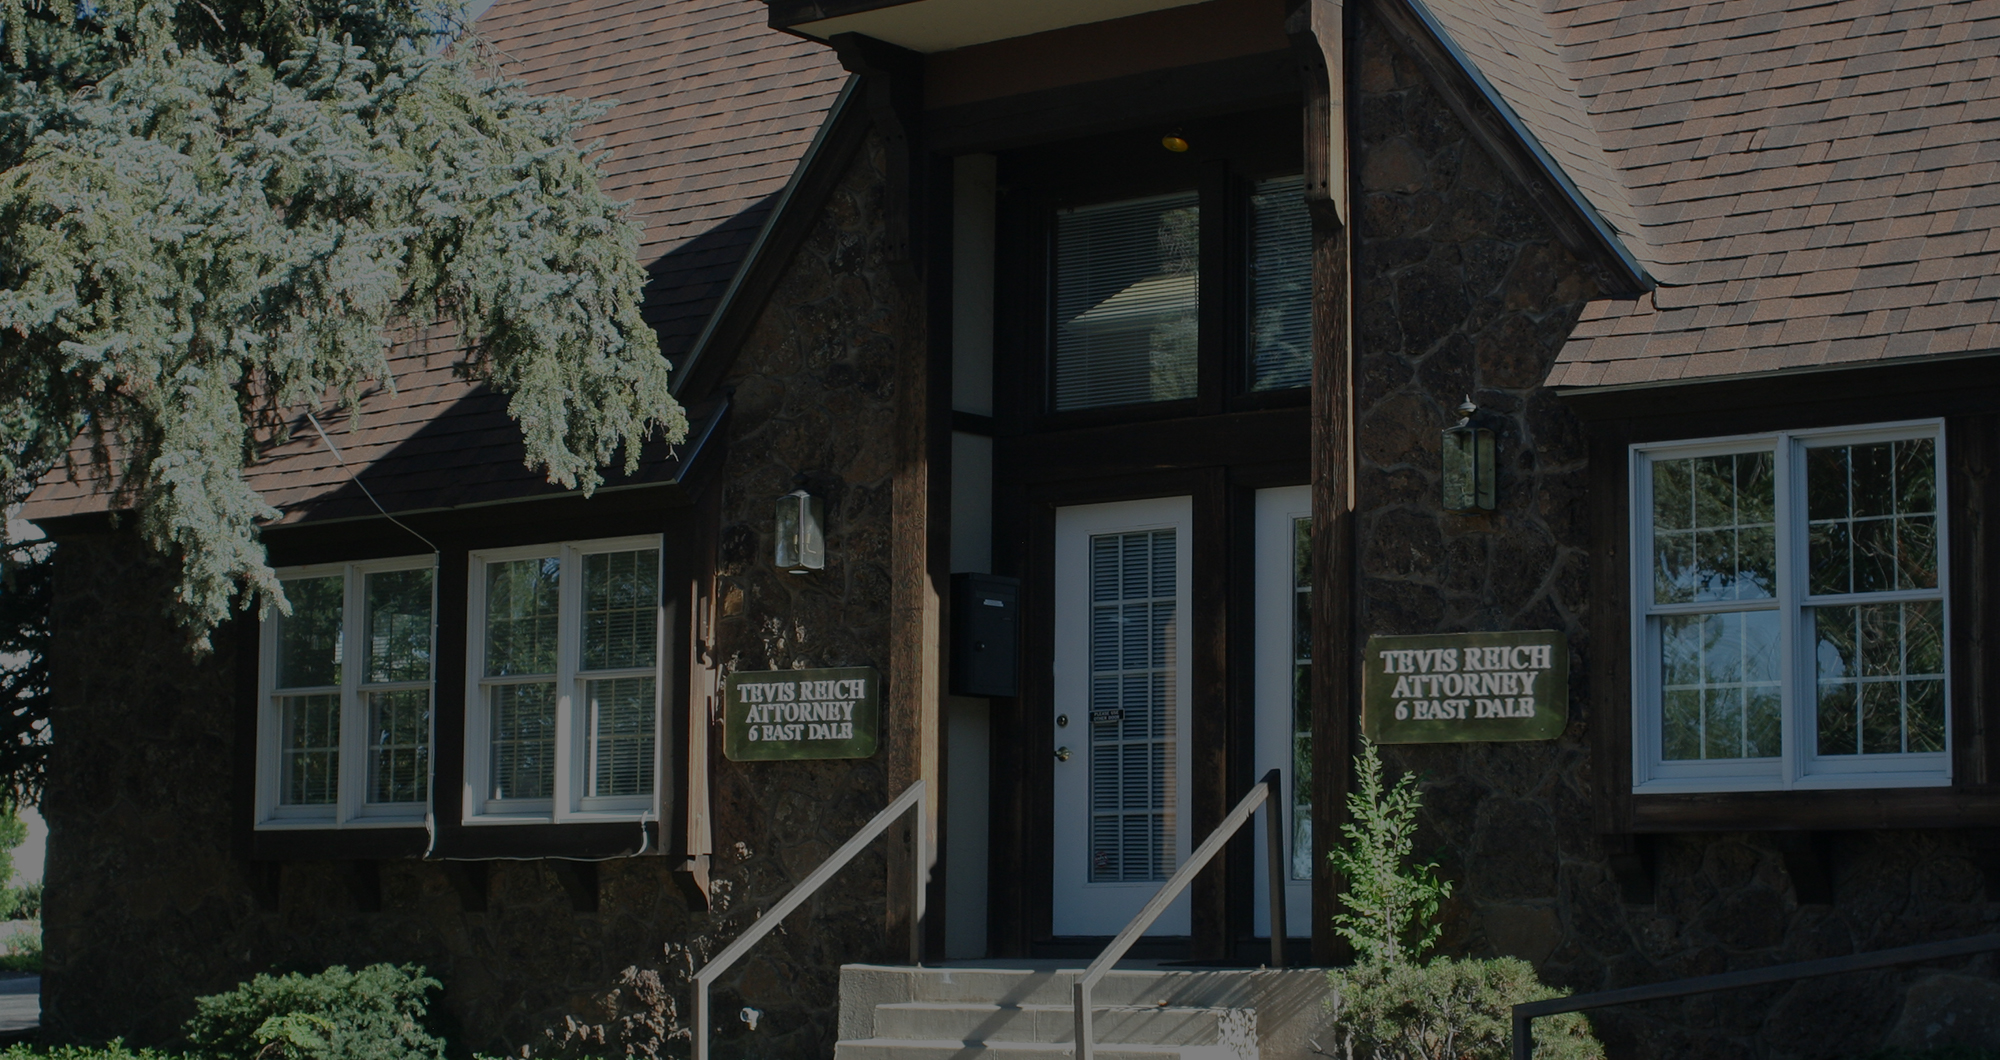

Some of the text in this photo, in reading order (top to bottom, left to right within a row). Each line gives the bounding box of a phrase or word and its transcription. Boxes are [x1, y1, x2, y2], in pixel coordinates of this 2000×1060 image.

[1379, 645, 1551, 674] TEVIS REICH
[737, 680, 865, 703] TEVIS REICH
[1391, 671, 1539, 699] ATTORNEY
[745, 701, 855, 722] ATTORNEY
[1395, 697, 1535, 720] 6 EAST DALE
[748, 722, 853, 741] 6 EAST DALE
